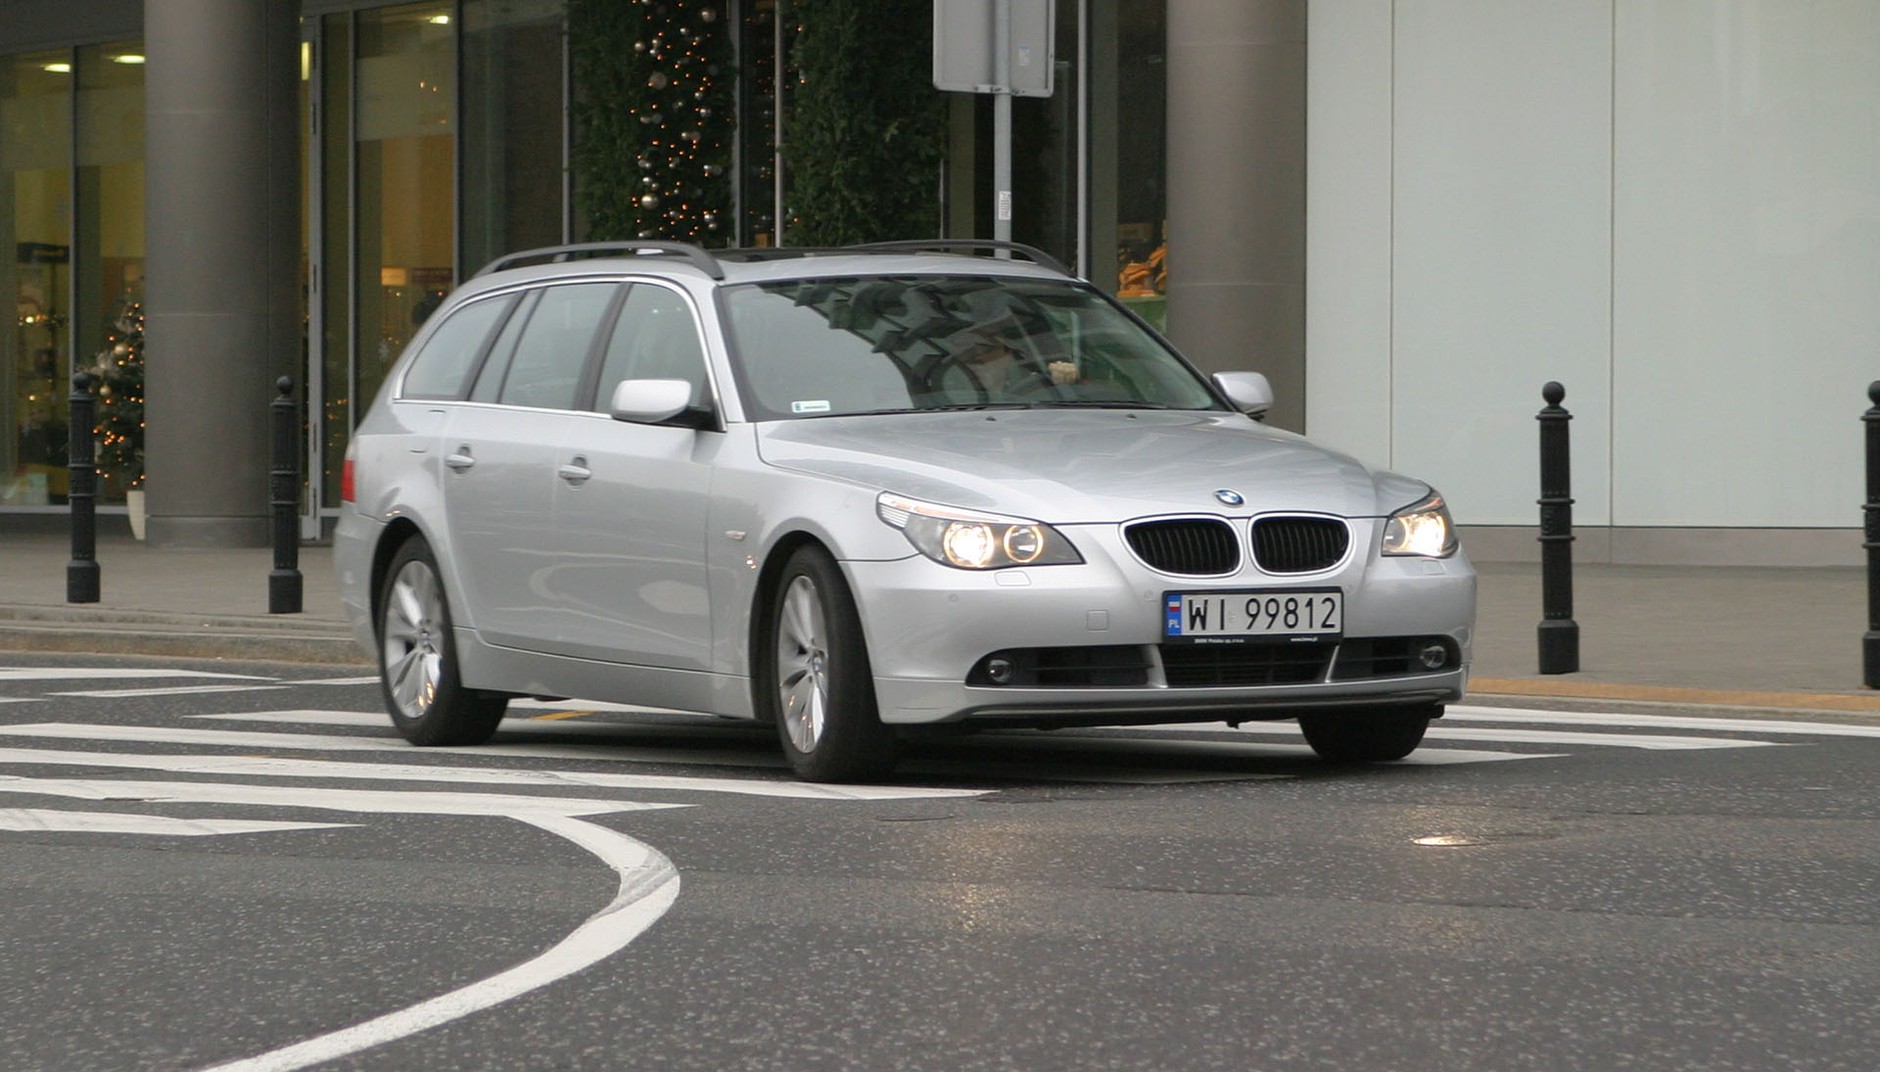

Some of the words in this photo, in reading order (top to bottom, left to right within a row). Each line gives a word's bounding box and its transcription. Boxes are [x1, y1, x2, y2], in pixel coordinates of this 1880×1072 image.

[1168, 619, 1180, 628] PL
[1188, 599, 1225, 631] WI
[1245, 597, 1336, 630] 99812
